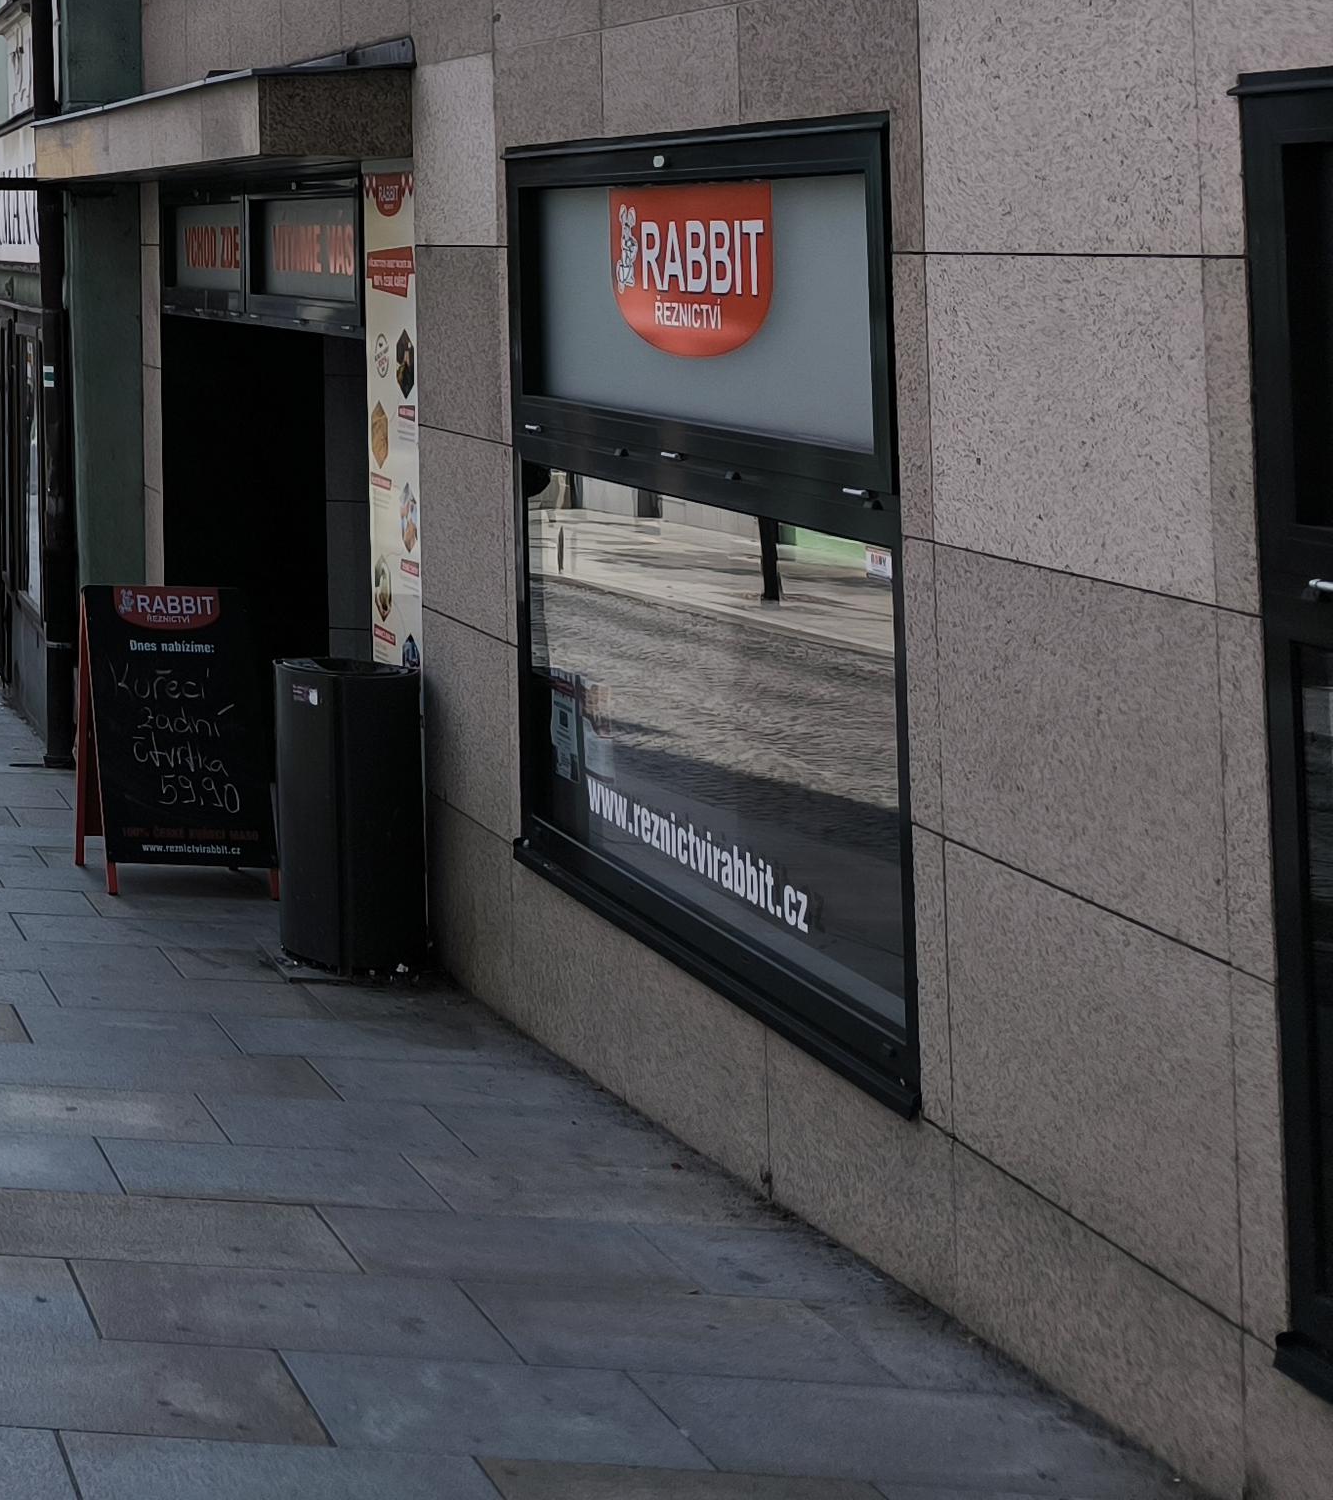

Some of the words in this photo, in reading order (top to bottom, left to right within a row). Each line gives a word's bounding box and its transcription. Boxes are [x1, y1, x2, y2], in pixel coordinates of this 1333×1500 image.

[185, 225, 217, 268] VCHOD
[221, 226, 240, 269] ZDE
[641, 219, 764, 297] RABBIT
[654, 295, 722, 330] ŘEZNICTVÍ
[136, 594, 214, 616] RABBIT
[146, 613, 190, 624] ŘEZNICTVÍ
[129, 639, 157, 652] Dnes
[161, 639, 215, 653] nabízíme:
[137, 703, 235, 737] zadní
[587, 777, 809, 934] www.reznictvirabbit.cz
